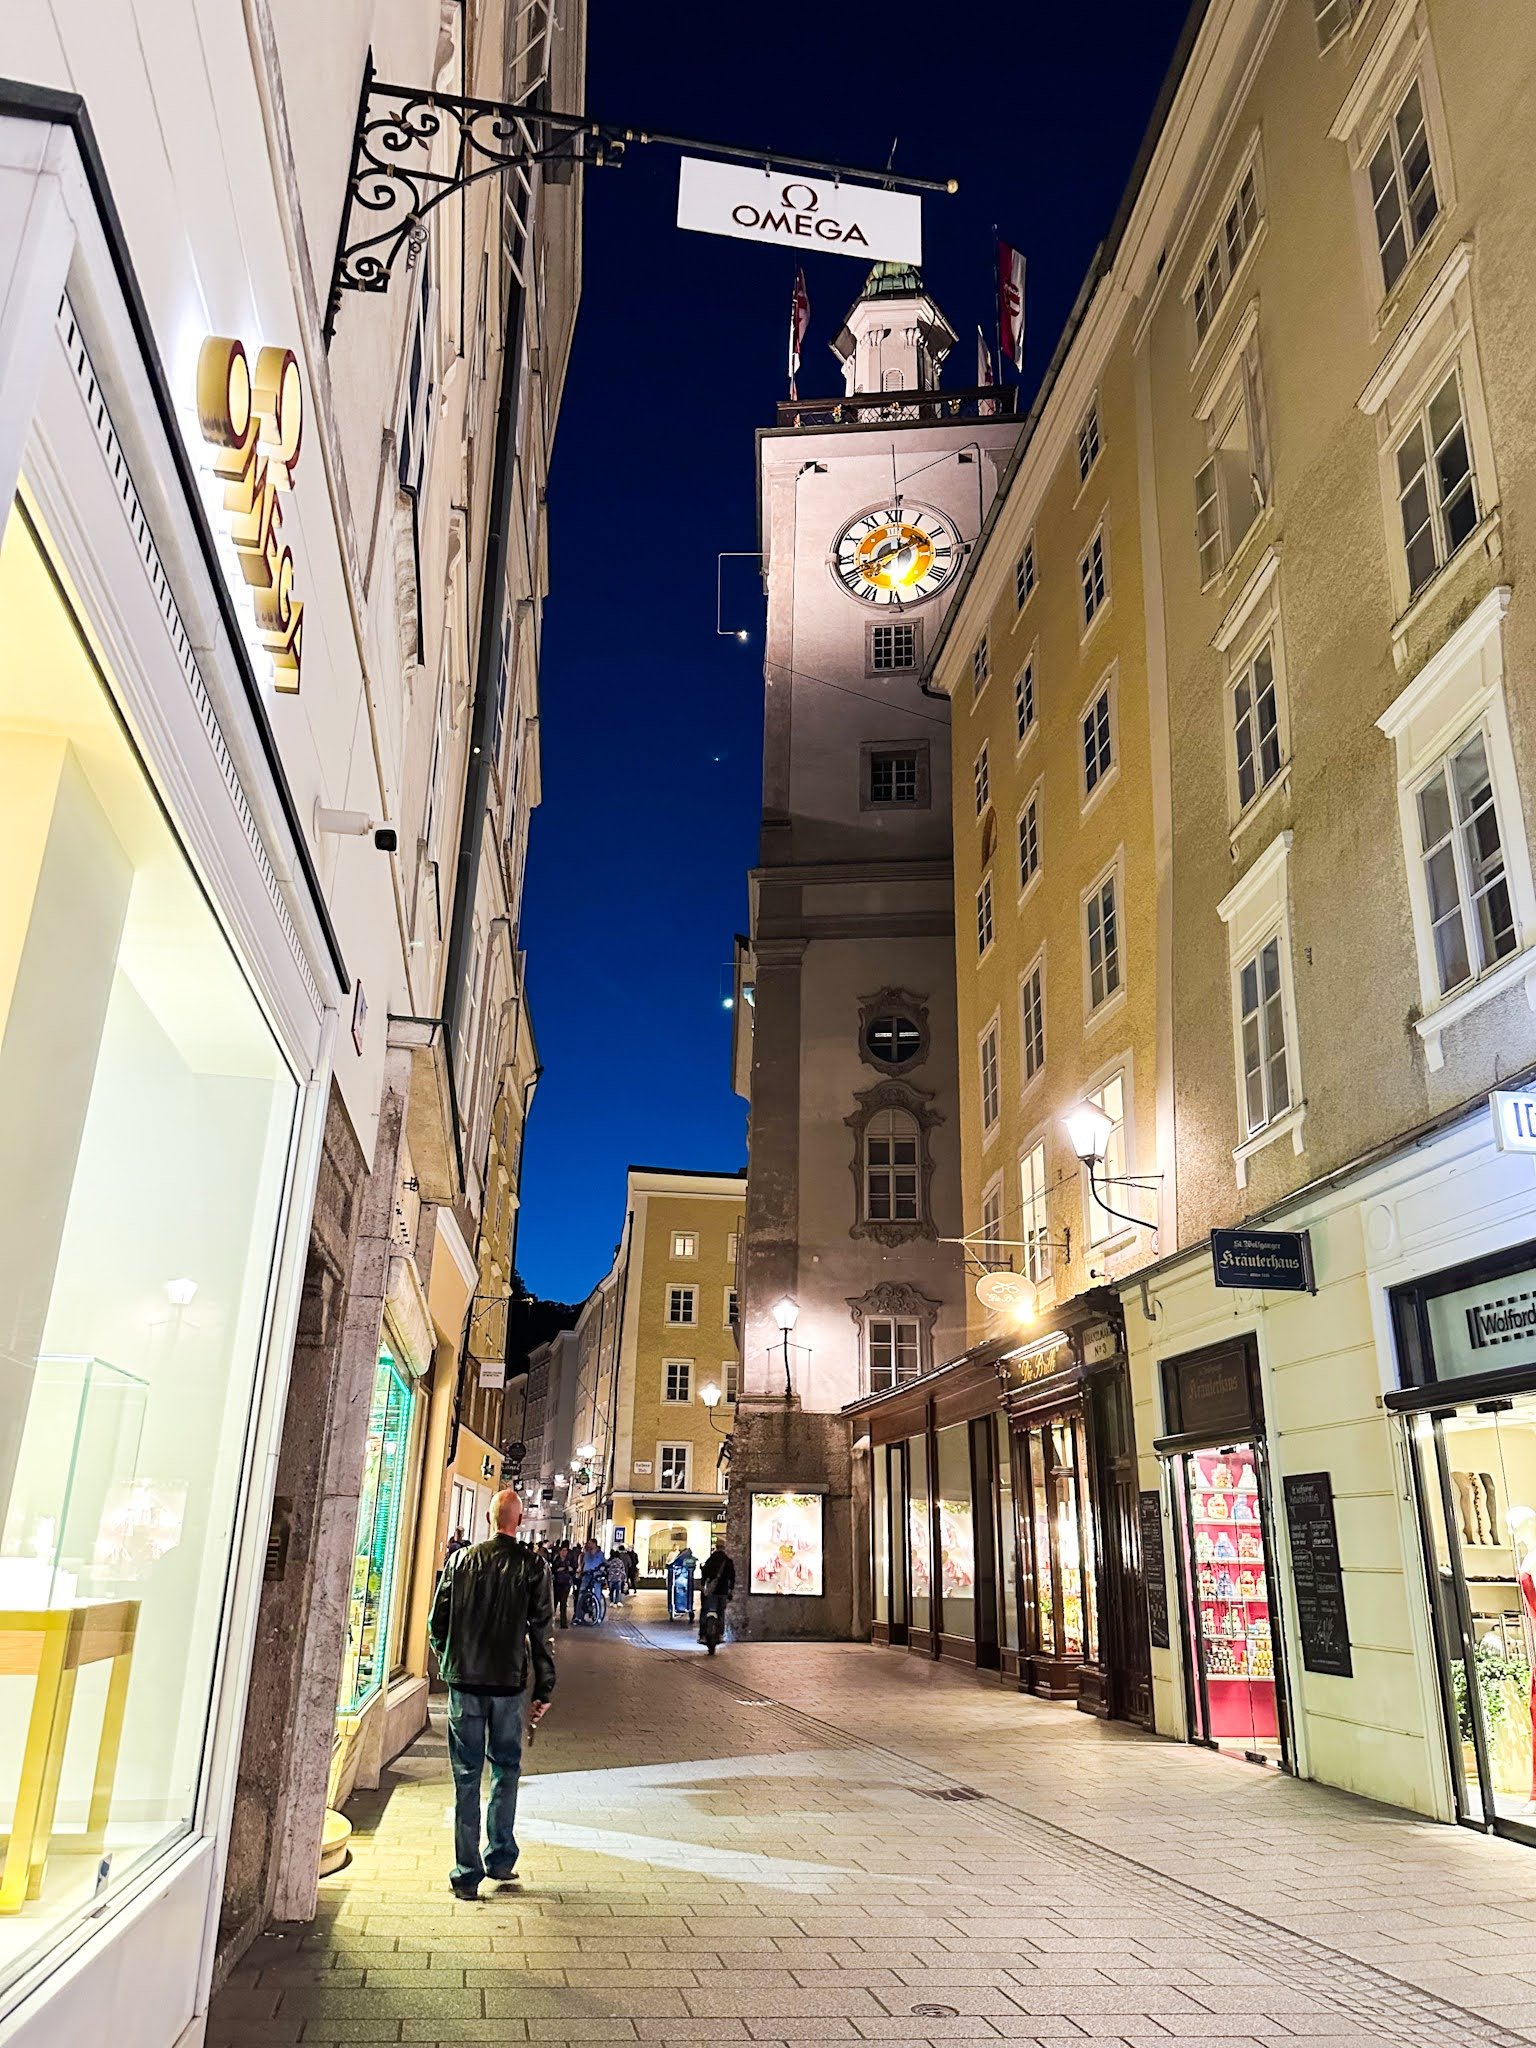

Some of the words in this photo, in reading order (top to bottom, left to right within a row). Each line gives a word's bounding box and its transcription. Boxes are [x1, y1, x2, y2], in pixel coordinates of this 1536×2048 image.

[731, 204, 869, 246] OMEGA
[1219, 1250, 1300, 1270] Kräuterhaus
[1480, 1303, 1536, 1336] Wolford
